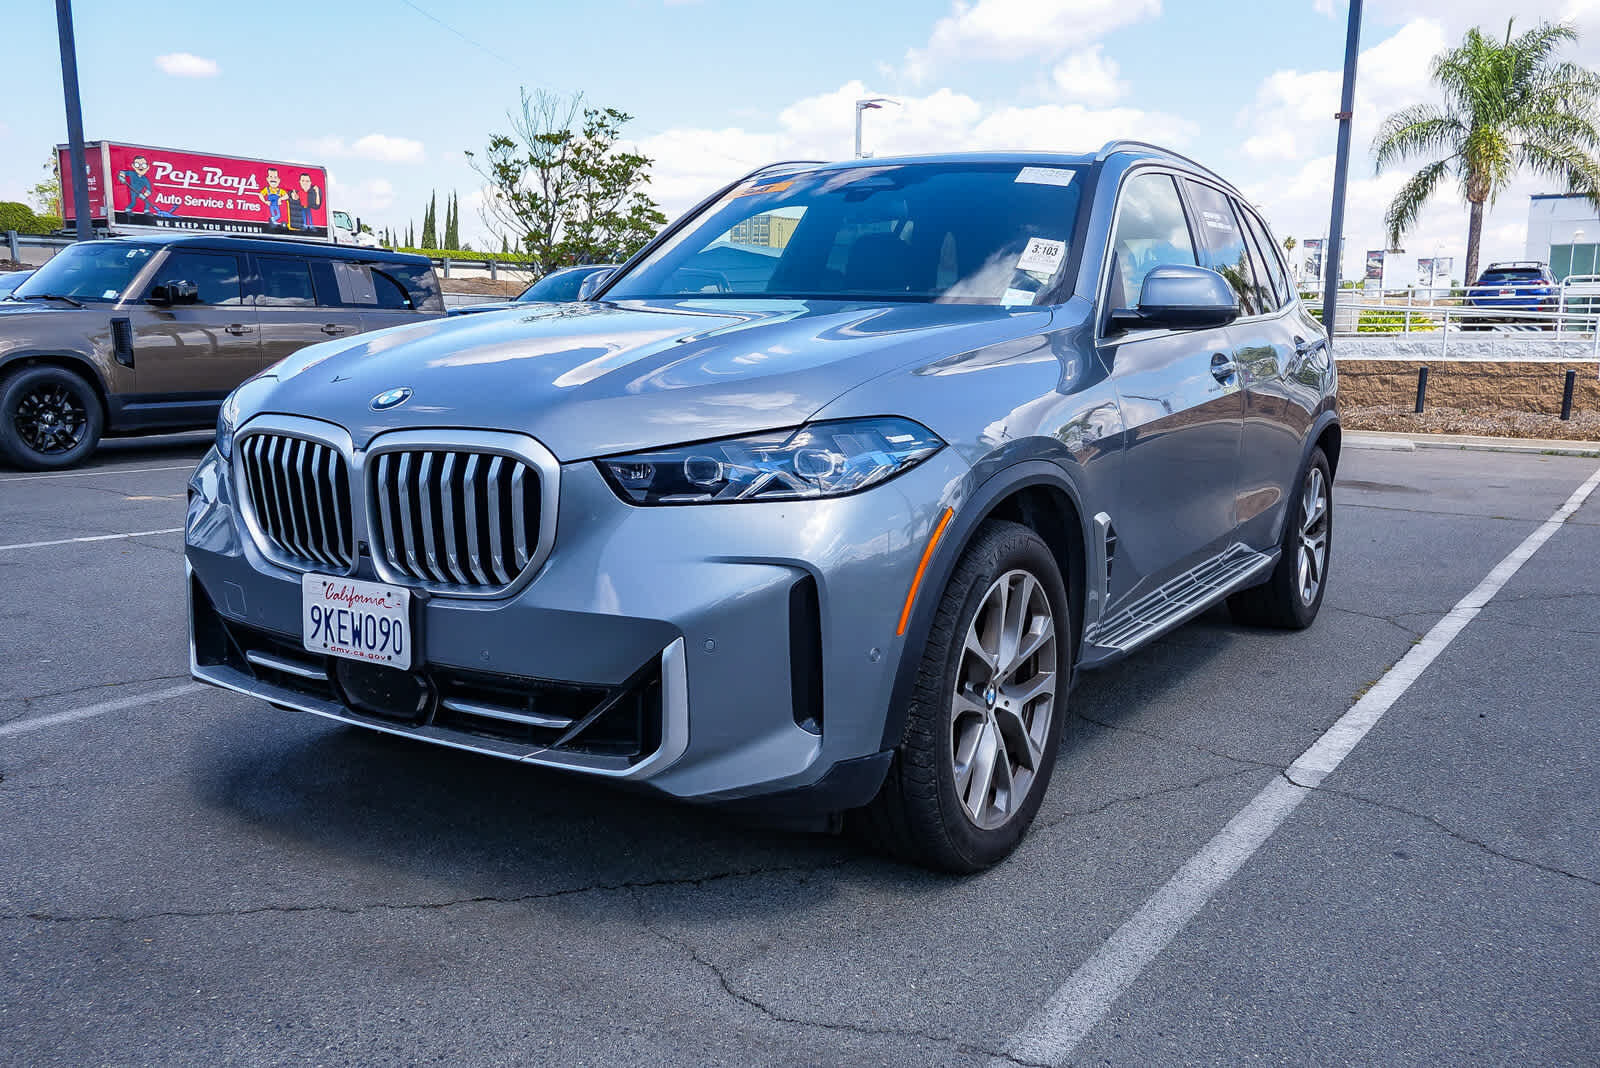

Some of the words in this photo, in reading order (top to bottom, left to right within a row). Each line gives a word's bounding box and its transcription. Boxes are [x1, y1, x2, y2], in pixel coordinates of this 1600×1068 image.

[152, 161, 200, 188] Pep
[202, 166, 259, 196] Boys
[155, 193, 182, 205] Auto
[184, 195, 224, 209] Service
[226, 199, 234, 209] &
[236, 200, 261, 211] Tires
[175, 221, 199, 229] KEEP
[325, 582, 392, 608] California
[311, 605, 403, 655] 9KEW090
[330, 645, 386, 660] dmv.ca.gov
